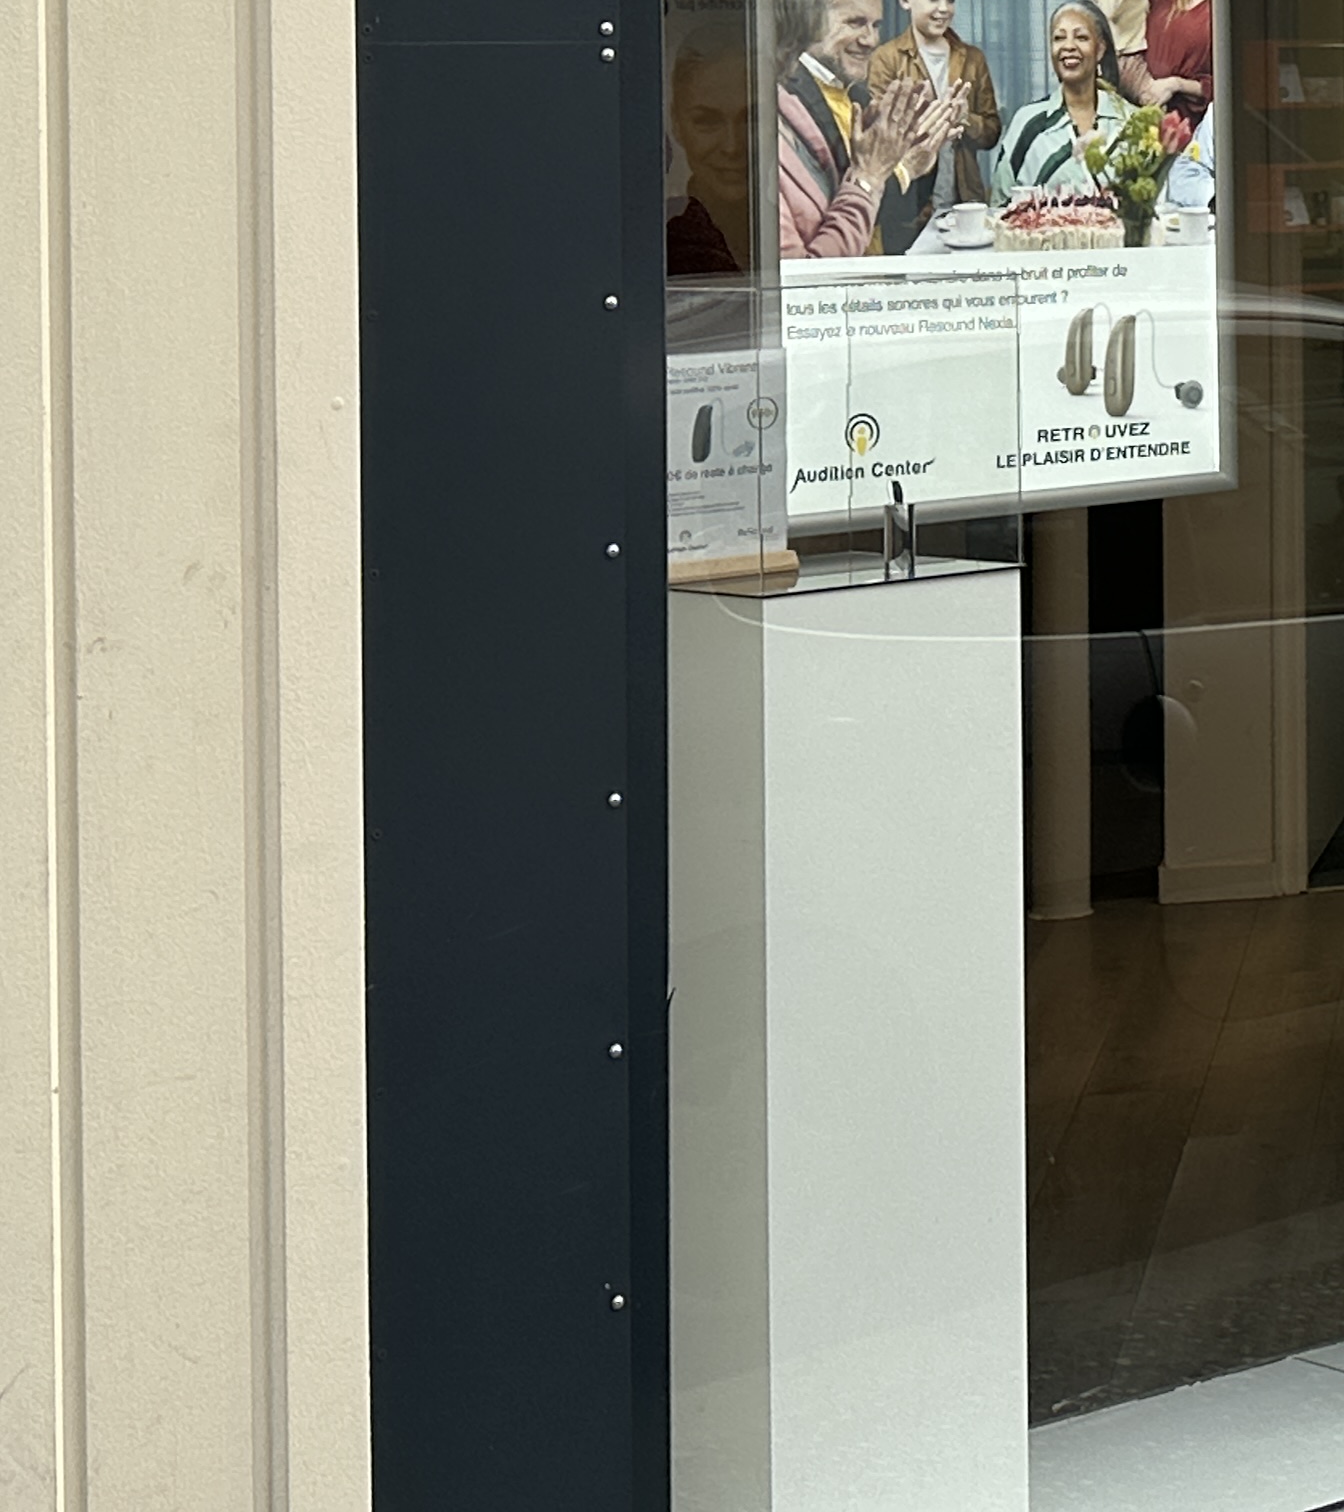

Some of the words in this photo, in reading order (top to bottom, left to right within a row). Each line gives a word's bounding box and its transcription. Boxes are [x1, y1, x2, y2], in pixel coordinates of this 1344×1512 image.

[1020, 268, 1048, 281] bruit
[1050, 267, 1063, 279] et
[1067, 264, 1109, 280] profiter
[1112, 264, 1127, 277] de
[787, 301, 814, 316] tous
[818, 300, 837, 314] les
[841, 297, 883, 313] détails
[888, 297, 939, 311] sonores
[942, 295, 963, 312] qui
[966, 295, 995, 308] vous
[787, 323, 841, 341] Essayez
[859, 321, 914, 337] nouveau
[996, 454, 1016, 469] LE
[1021, 448, 1084, 467] PLAISIR
[1089, 440, 1191, 462] D'ENTENDRE
[789, 464, 865, 494] Audition
[871, 457, 936, 478] Center
